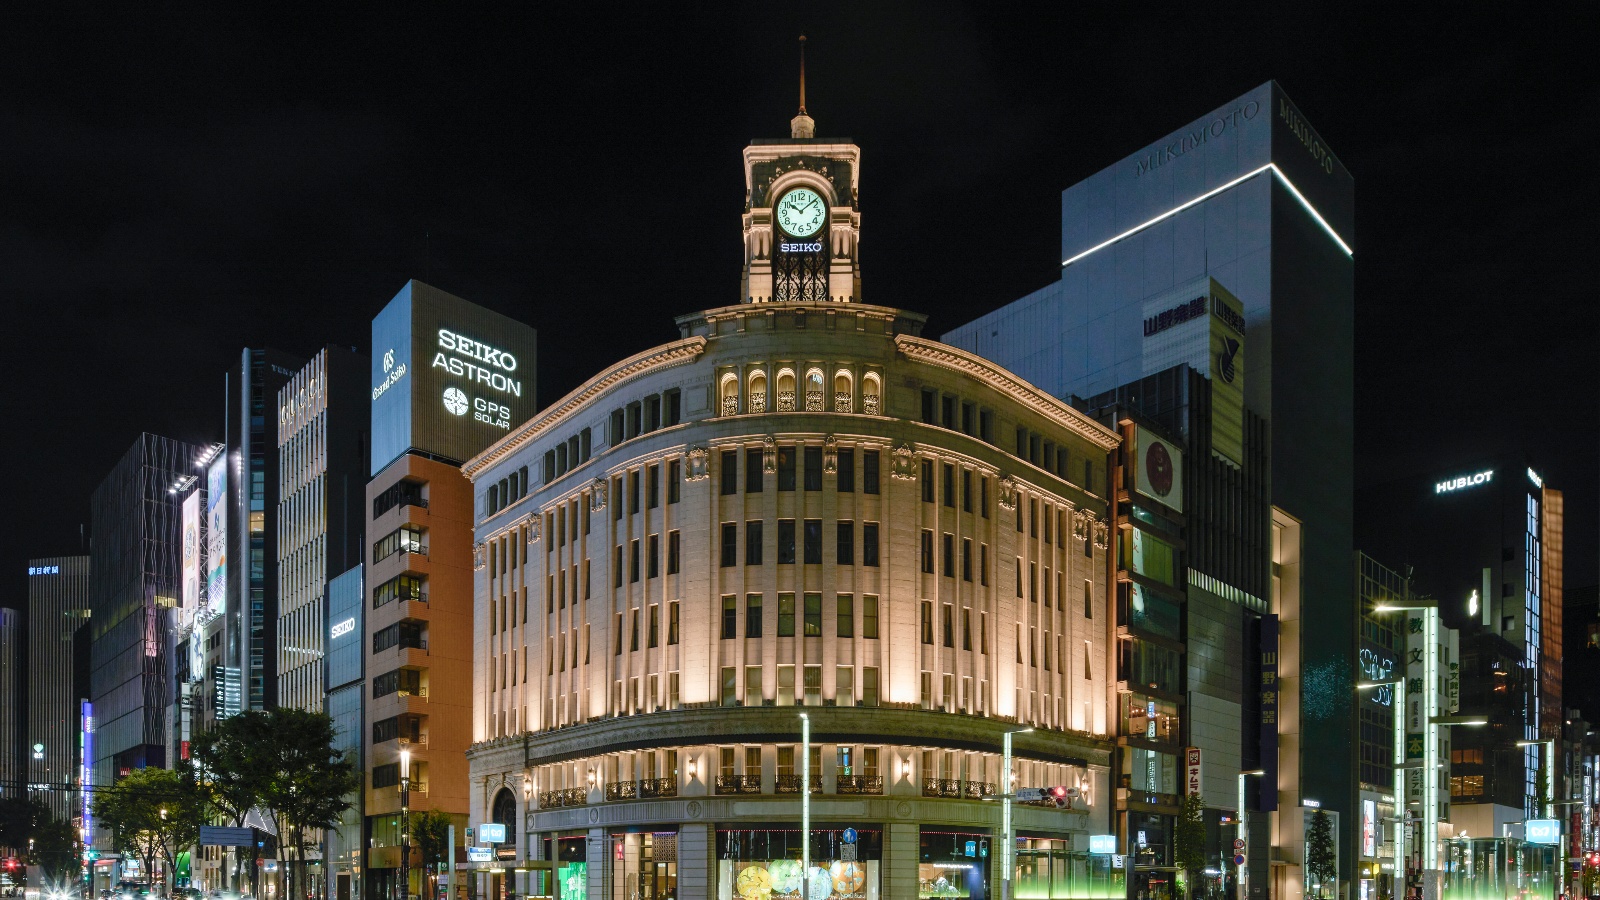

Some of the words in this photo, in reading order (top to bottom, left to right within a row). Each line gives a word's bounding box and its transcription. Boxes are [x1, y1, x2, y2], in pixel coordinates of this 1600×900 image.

[1137, 101, 1259, 176] MIKIMOTO
[1280, 98, 1333, 174] MIKIMOTO
[784, 201, 790, 209] 10
[798, 193, 806, 201] 12
[813, 200, 819, 208] 2
[782, 209, 788, 218] 9
[784, 217, 790, 225] 8
[812, 216, 818, 224] 4
[816, 208, 822, 216] 3
[790, 222, 798, 230] 7
[798, 224, 804, 233] 6
[806, 222, 812, 230] 5
[781, 242, 822, 252] SEIKO
[1143, 296, 1208, 337] 山野楽器
[1214, 296, 1246, 338] 山野楽器
[438, 329, 517, 371] SEIKO
[372, 375, 390, 401] Grand
[390, 362, 406, 385] Seiko
[432, 353, 520, 397] ASTRON
[281, 371, 324, 426] GUCCI
[475, 397, 510, 419] GPS
[474, 411, 510, 430] SOLAR
[1436, 470, 1493, 494] HUBLOT
[331, 617, 355, 639] SEIKO
[1408, 617, 1424, 694] 教文館
[1262, 651, 1276, 724] 山野楽器
[1408, 737, 1423, 755] 本
